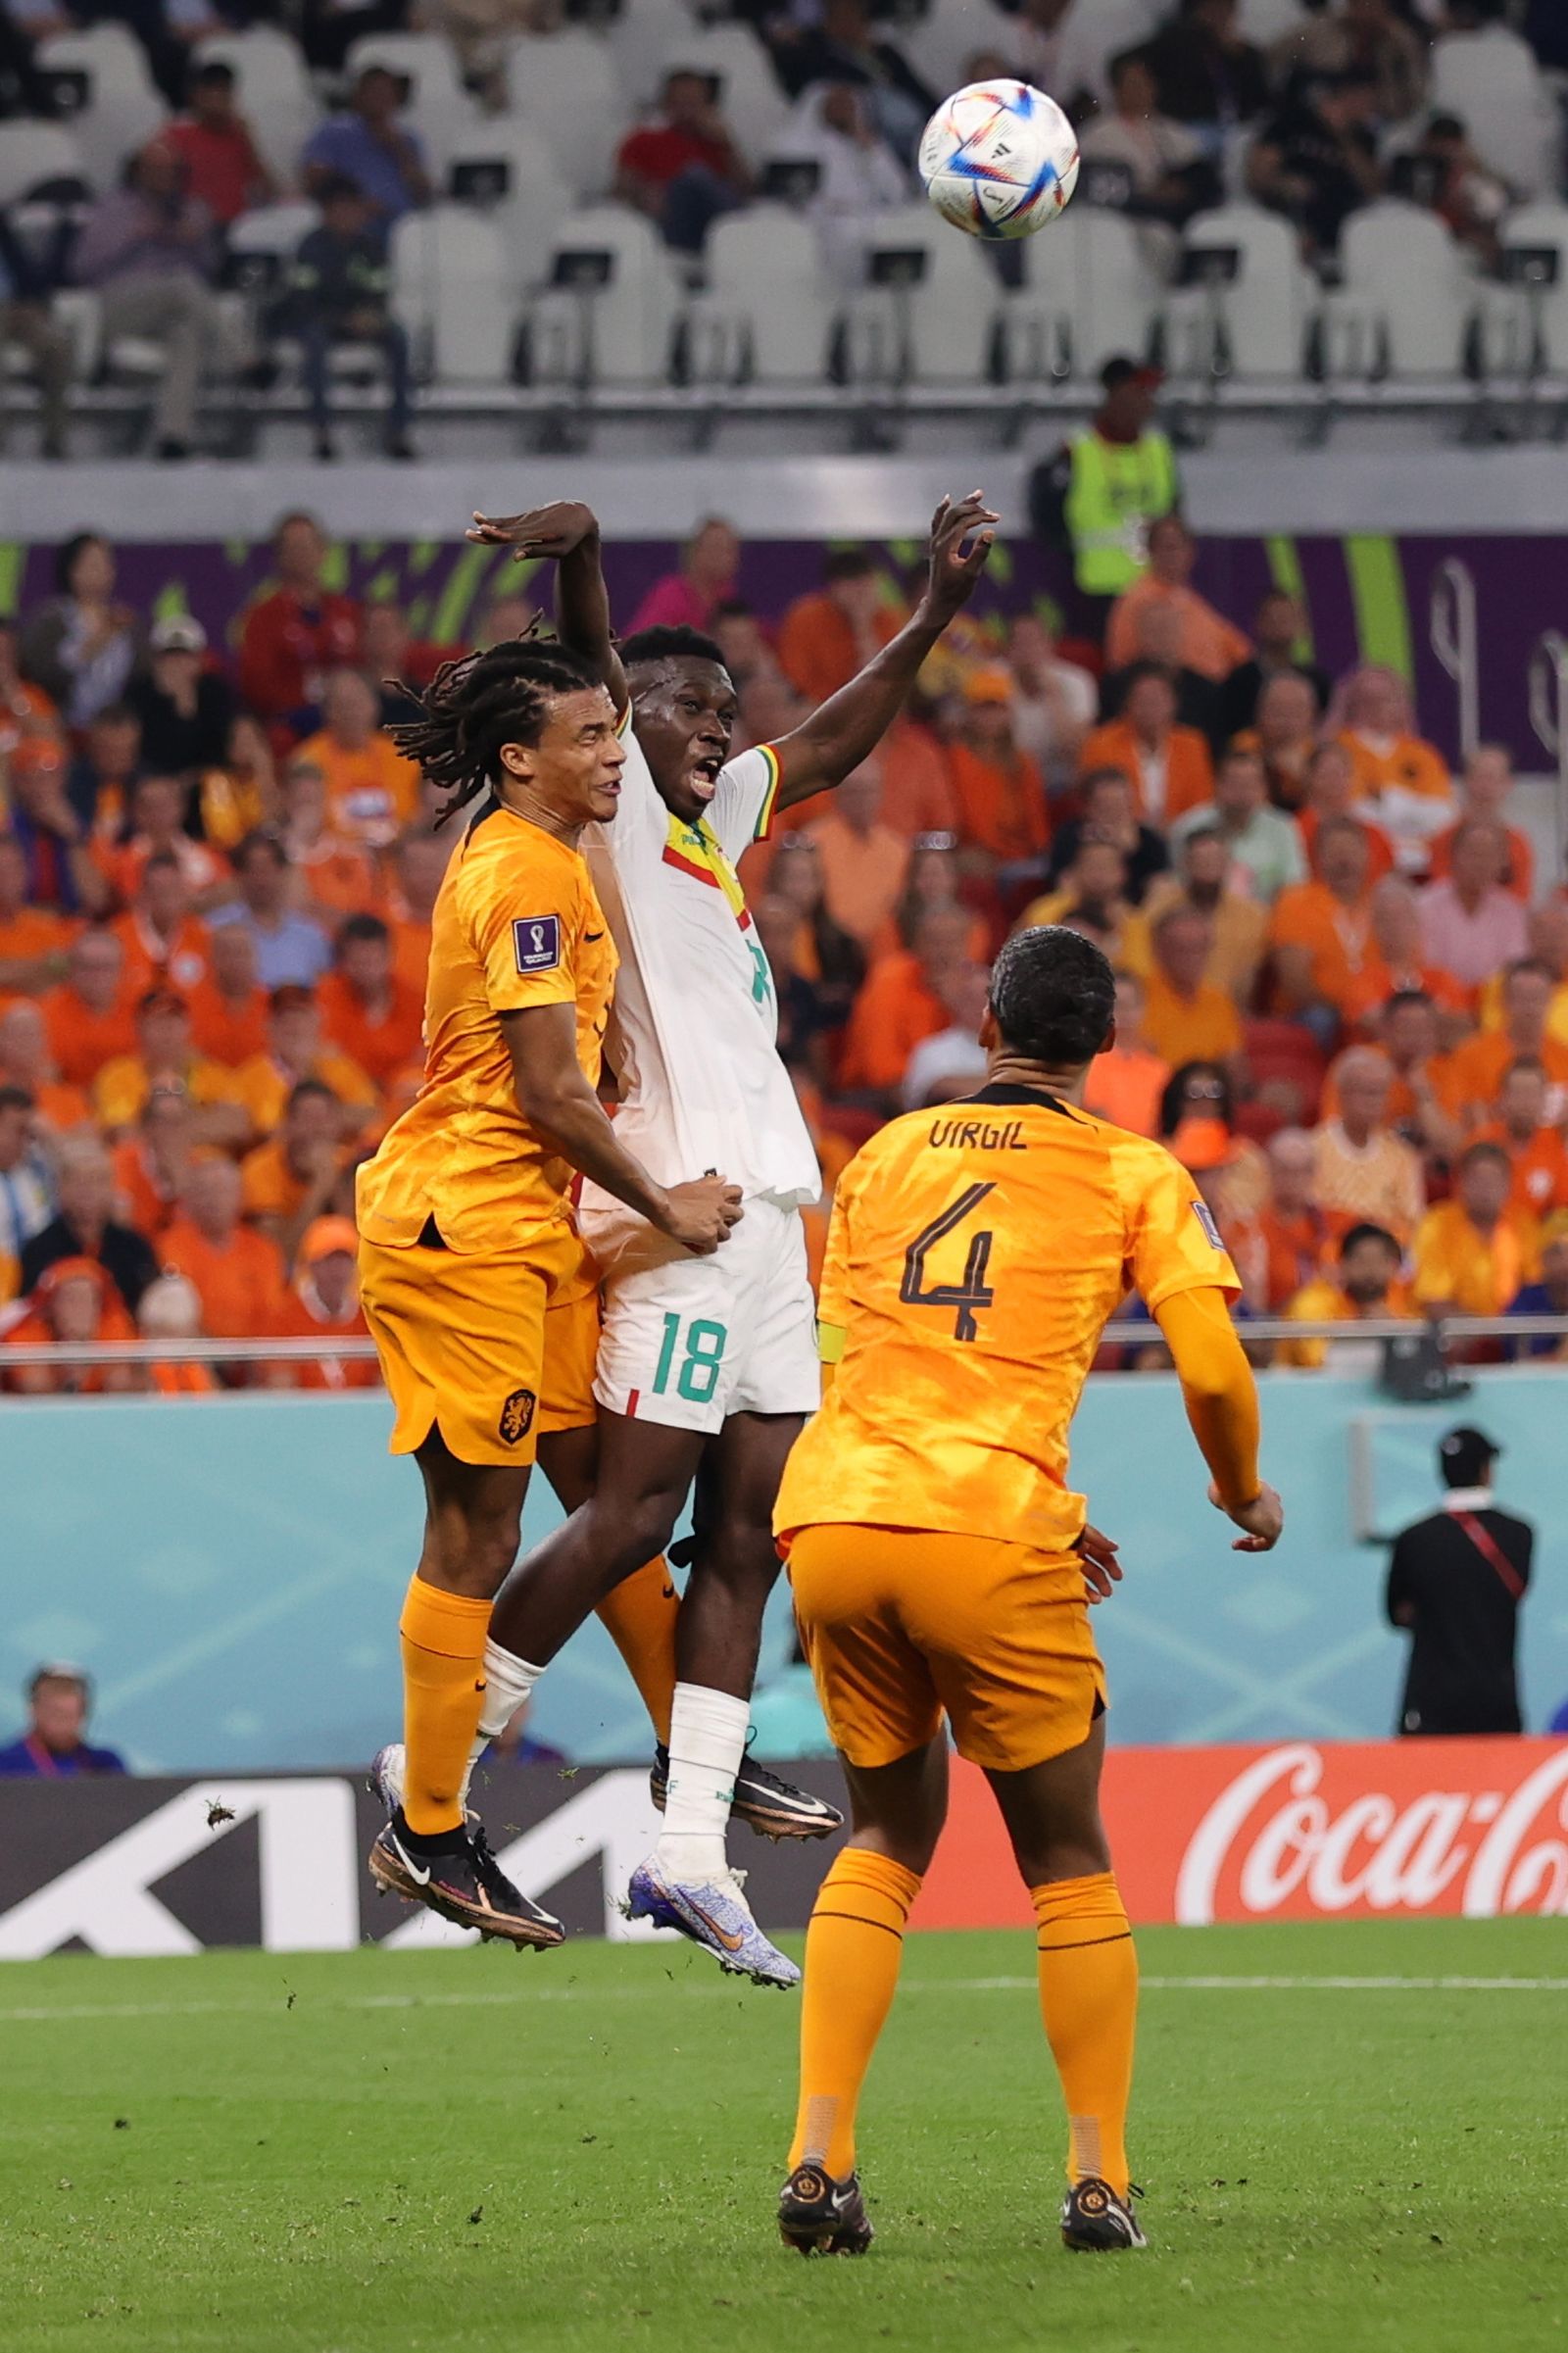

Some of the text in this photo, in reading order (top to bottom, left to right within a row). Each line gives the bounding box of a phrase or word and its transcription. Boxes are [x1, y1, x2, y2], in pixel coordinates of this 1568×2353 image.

[929, 1119, 1027, 1151] VIRGIL
[899, 1182, 998, 1342] 4
[652, 1311, 727, 1403] 18
